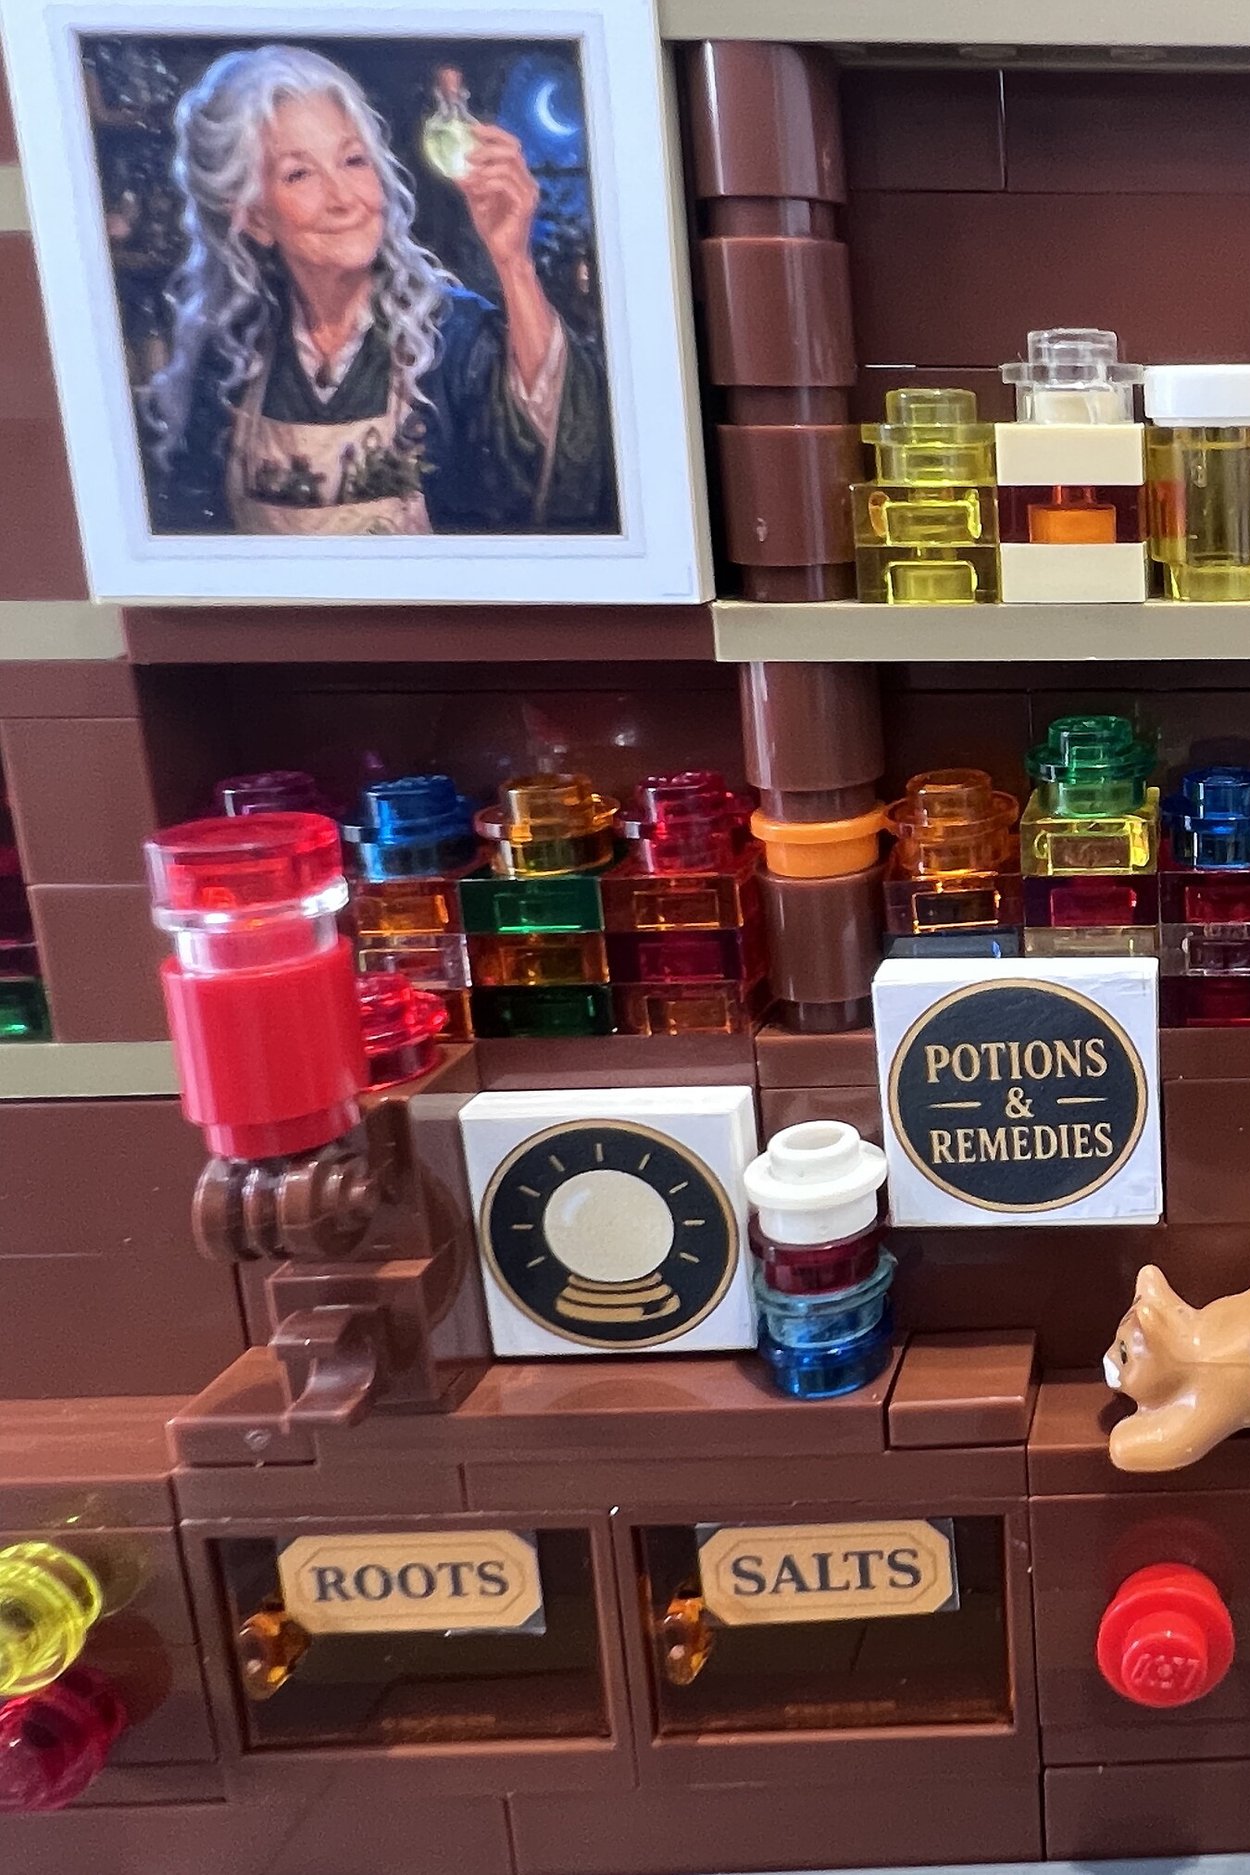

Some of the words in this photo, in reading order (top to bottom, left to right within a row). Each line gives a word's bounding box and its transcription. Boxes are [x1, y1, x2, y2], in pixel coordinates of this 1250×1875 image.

[925, 1038, 1108, 1083] POTIONS
[1004, 1086, 1035, 1119] &
[929, 1122, 1114, 1165] REMEDIES
[311, 1560, 509, 1603] ROOTS
[731, 1548, 922, 1596] SALTS
